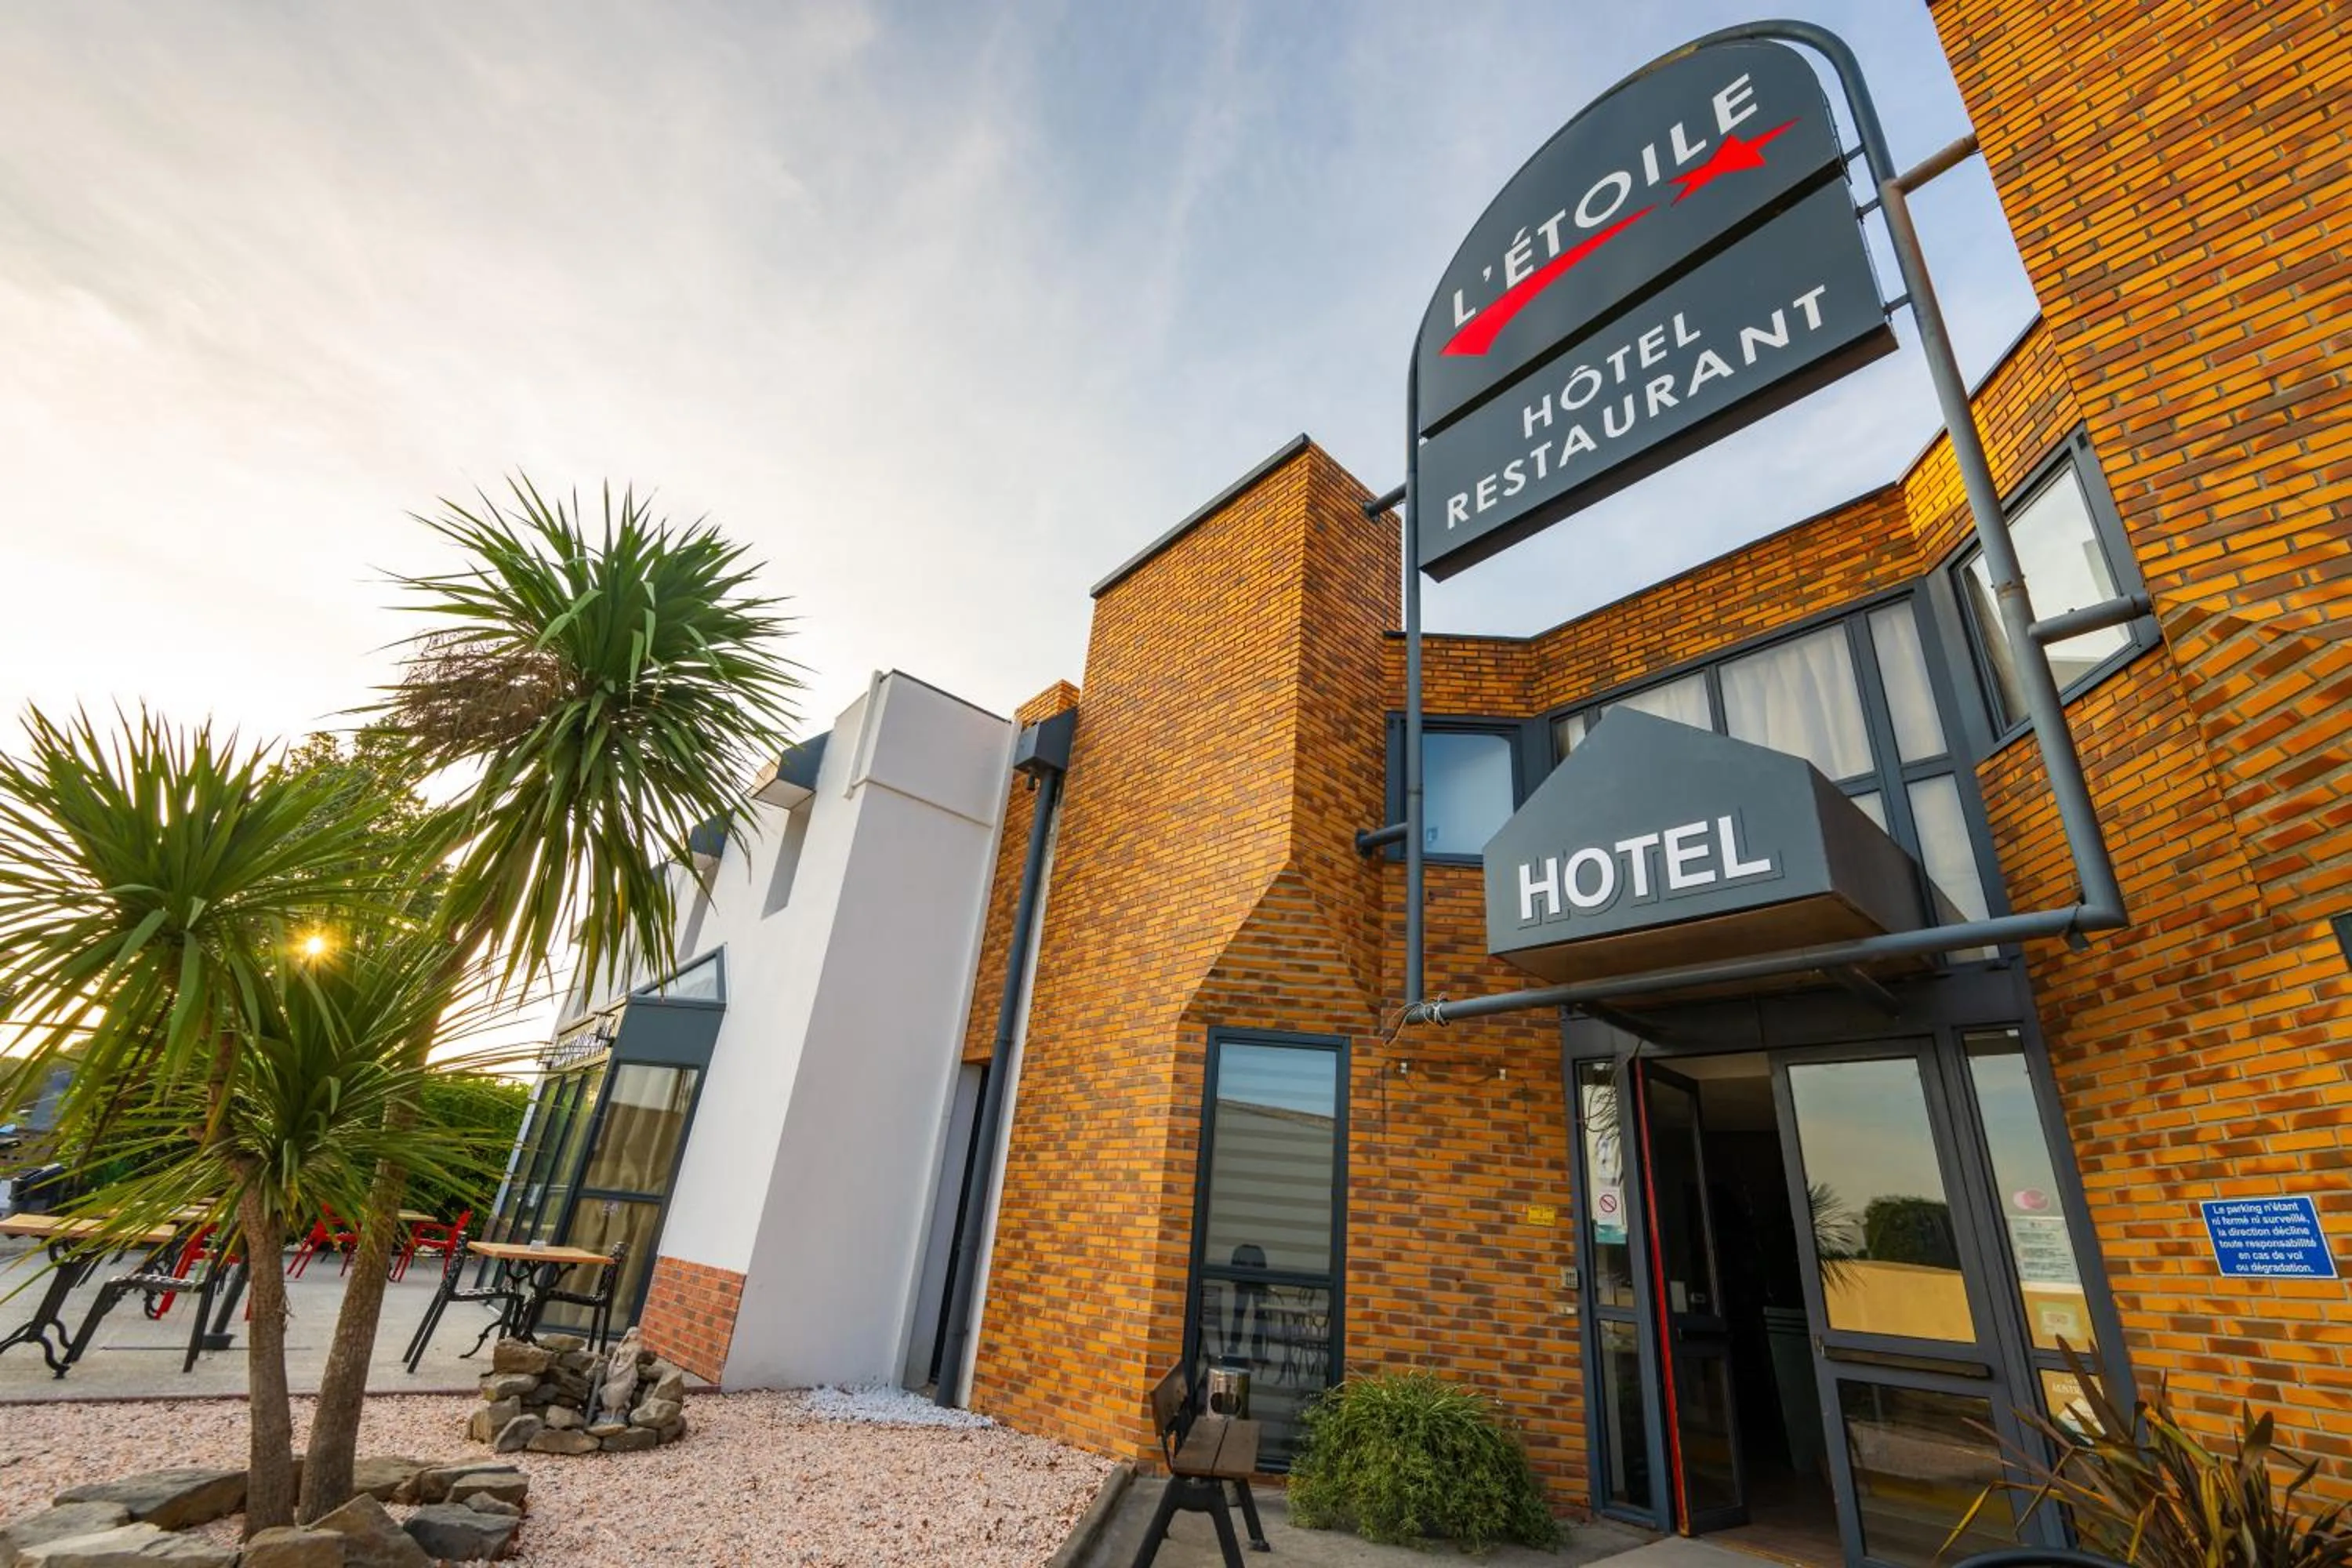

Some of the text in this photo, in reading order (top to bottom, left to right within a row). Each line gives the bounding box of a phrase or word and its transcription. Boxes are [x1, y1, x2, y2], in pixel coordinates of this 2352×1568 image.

[1453, 72, 1758, 329] L'ÉTOILE
[1523, 311, 1700, 439] HÔTEL
[1446, 285, 1826, 530] RESTAURANT
[1519, 815, 1772, 920] HOTEL
[2212, 1202, 2299, 1215] Le parking n'étant
[2222, 1216, 2249, 1225] fermé
[2228, 1226, 2270, 1236] direction
[2272, 1225, 2310, 1235] décline
[2219, 1238, 2316, 1250] toute responsabilité
[2272, 1250, 2285, 1259] de
[2286, 1250, 2303, 1259] vol
[2251, 1262, 2314, 1273] dégradation.
